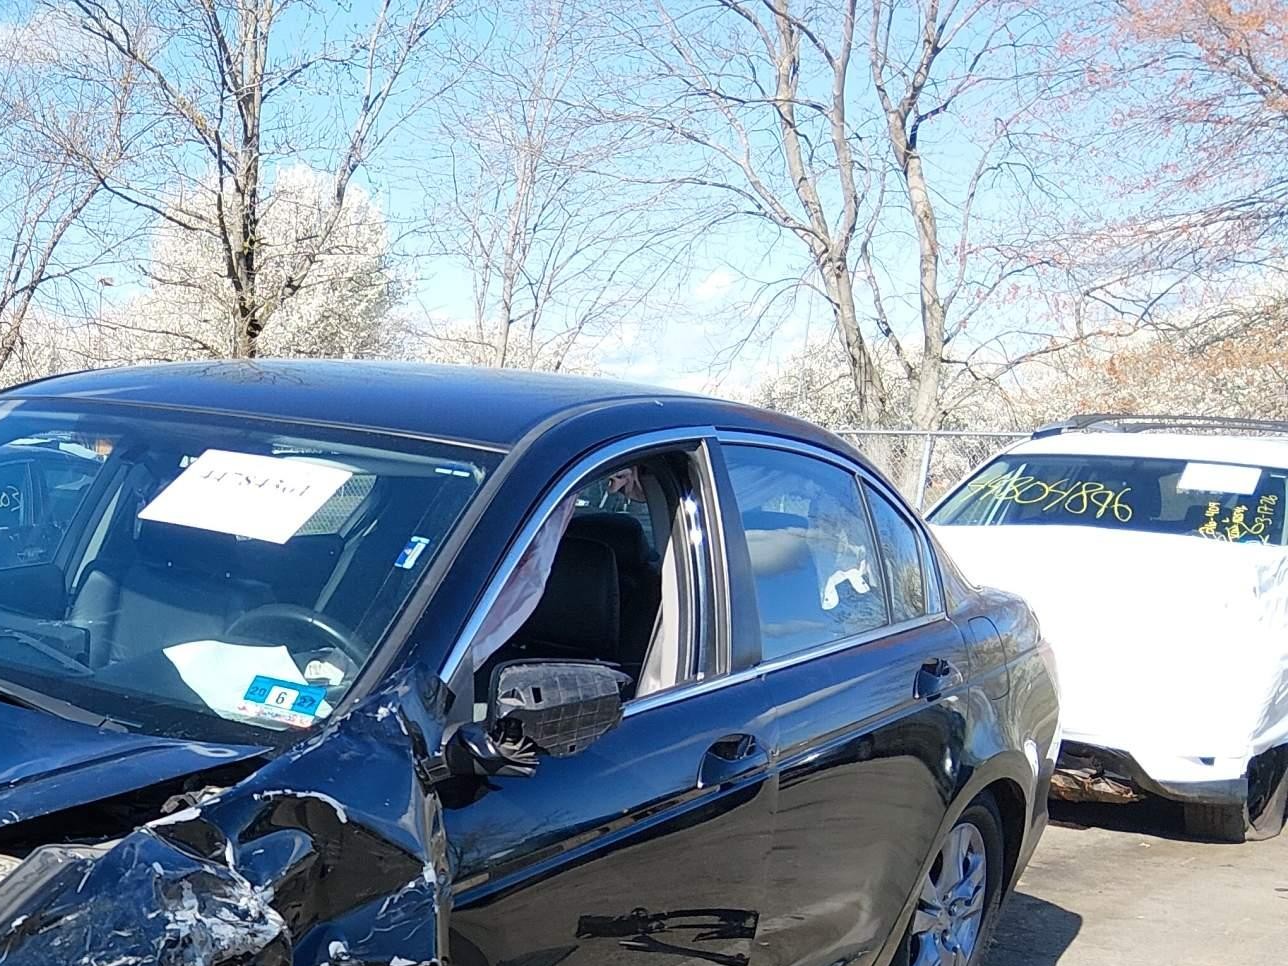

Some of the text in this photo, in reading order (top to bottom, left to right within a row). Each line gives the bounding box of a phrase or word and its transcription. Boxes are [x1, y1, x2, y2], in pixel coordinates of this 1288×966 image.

[249, 686, 316, 708] 20 6 27
